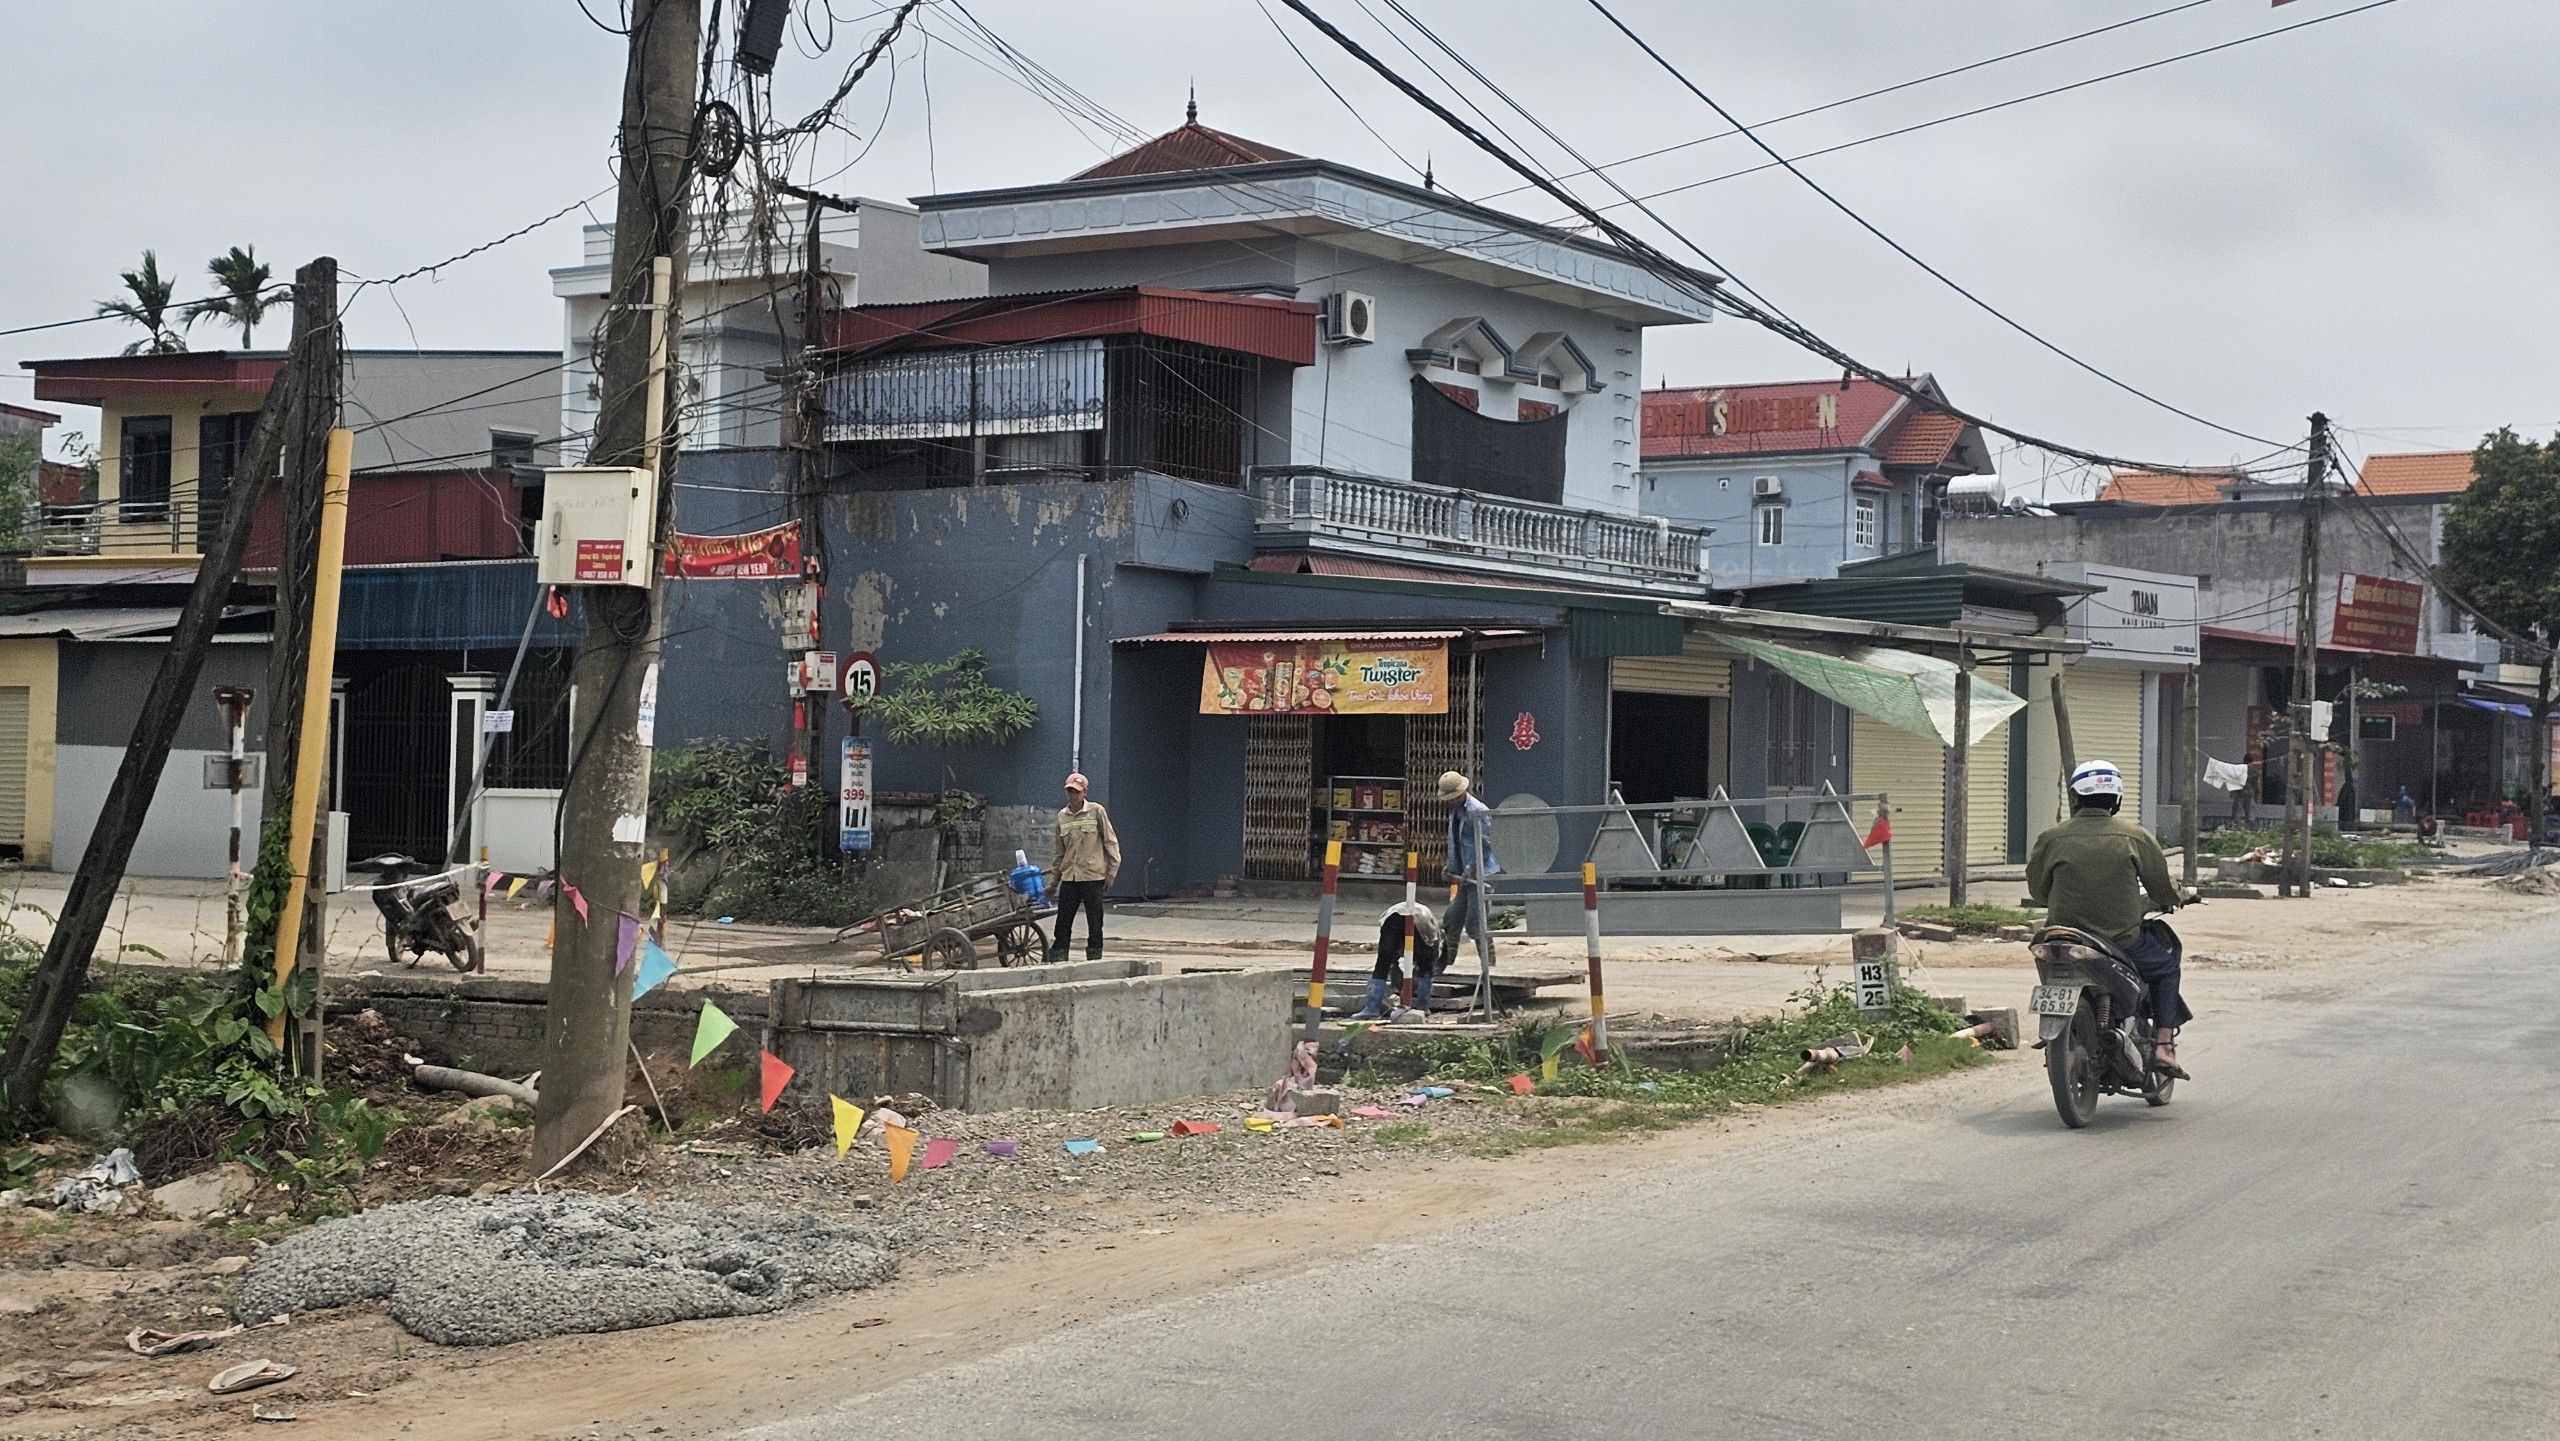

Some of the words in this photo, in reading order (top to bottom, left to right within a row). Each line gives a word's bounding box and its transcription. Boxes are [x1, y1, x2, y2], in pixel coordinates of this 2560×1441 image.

[1377, 658, 1408, 669] Tropicana
[849, 669, 871, 698] 15
[1359, 666, 1421, 687] Twister
[1860, 964, 1883, 981] H3
[1863, 990, 1885, 1007] 25
